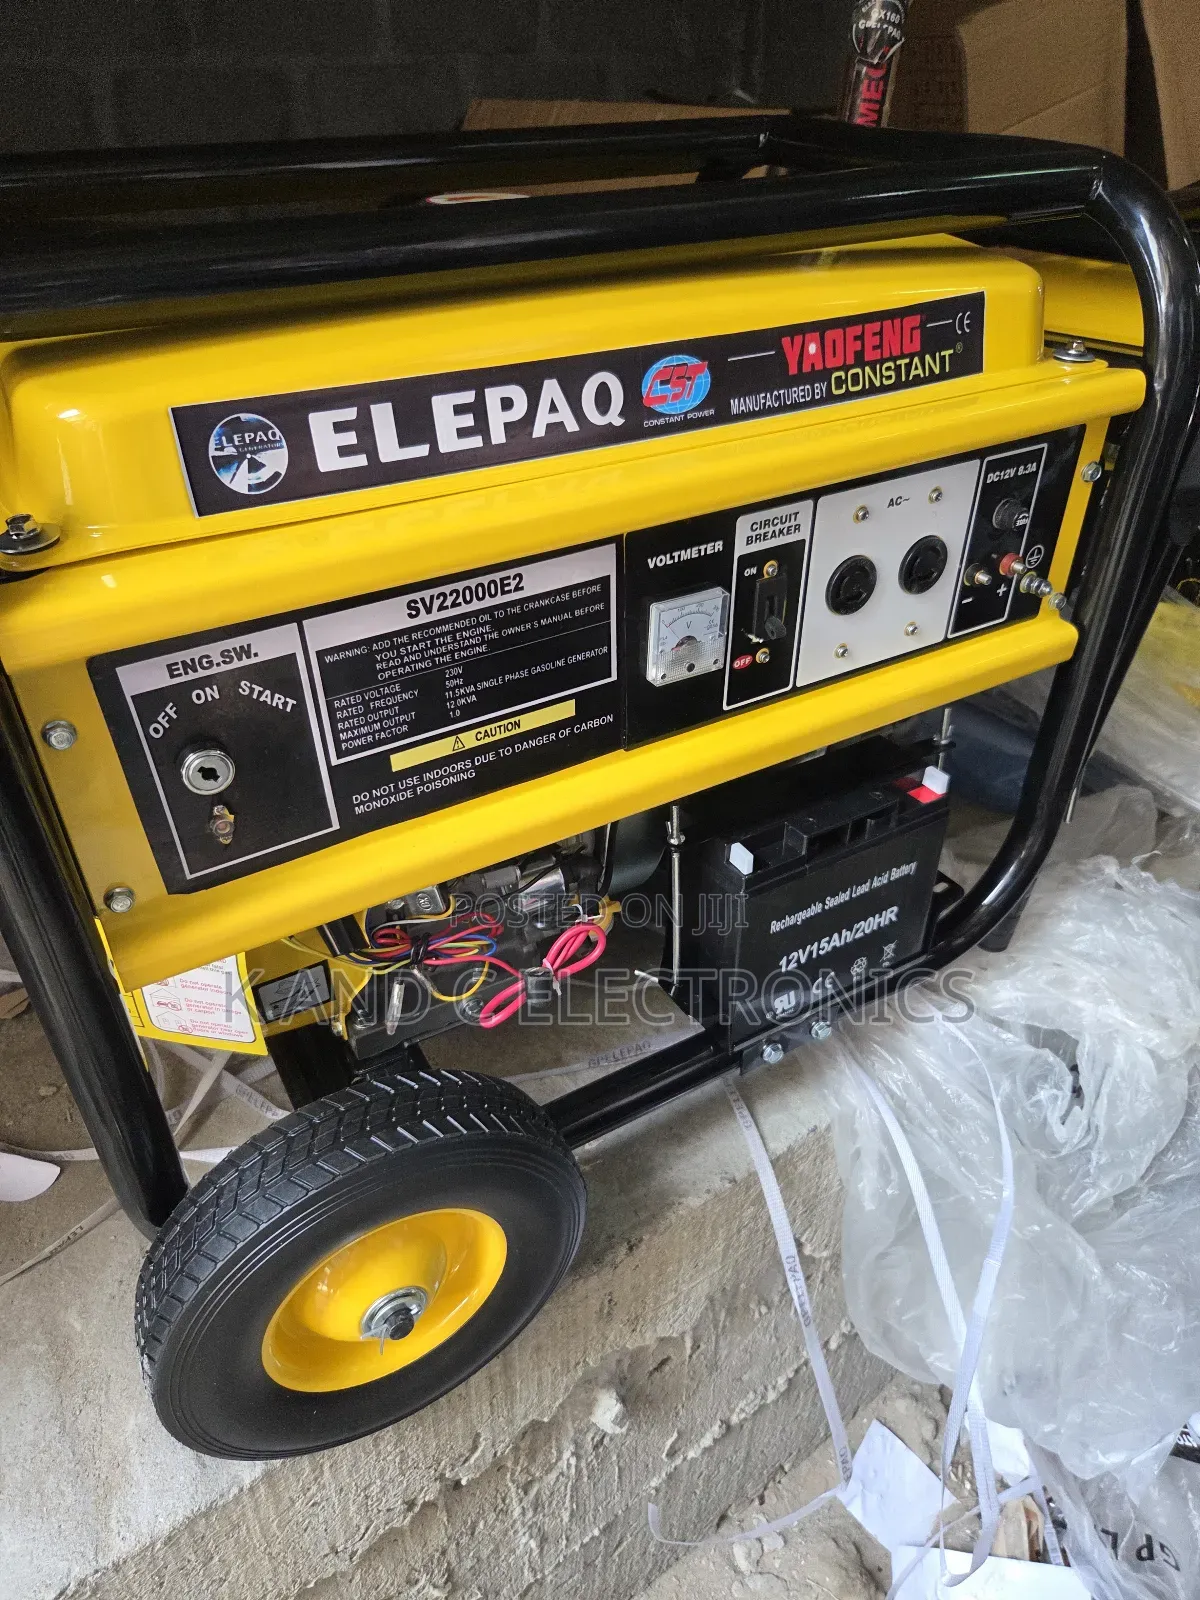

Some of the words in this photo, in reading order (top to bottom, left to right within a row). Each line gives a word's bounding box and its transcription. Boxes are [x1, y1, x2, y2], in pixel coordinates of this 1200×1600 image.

[781, 314, 921, 376] YAOFENG
[642, 361, 709, 408] CST
[730, 384, 813, 416] MANUFACTURED
[814, 381, 828, 400] BY
[831, 350, 954, 396] CONSTANT
[308, 371, 626, 473] ELEPAQ
[643, 413, 686, 428] CONSTANT
[686, 408, 715, 421] POWER
[212, 428, 282, 450] ELEPAQ
[986, 467, 1016, 484] DC12V
[1017, 462, 1037, 476] 8.3A
[745, 523, 801, 546] BREAKER
[749, 511, 800, 533] CIRCUIT
[647, 540, 724, 569] VOLTMETER
[743, 566, 758, 577] ON
[406, 572, 525, 619] SV22000E2
[324, 645, 371, 664] WARNING:
[372, 639, 391, 652] ADD
[393, 634, 410, 646] THE
[411, 616, 477, 641] RECOMMENDED
[478, 613, 492, 624] OIL
[494, 610, 505, 620] TO
[506, 605, 522, 617] THE
[523, 594, 571, 612] CRANKCASE
[572, 583, 602, 599] BEFORE
[375, 650, 397, 662] YOU
[400, 641, 432, 656] START
[434, 634, 453, 646] THE
[456, 624, 495, 640] ENGINE.
[376, 658, 401, 671] READ
[403, 652, 422, 664] AND
[423, 636, 482, 659] UNDERSTAND
[484, 629, 500, 641] THE
[501, 620, 539, 637] OWNER'S
[540, 612, 573, 628] MANUAL
[574, 602, 605, 618] BEFORE
[686, 620, 693, 629] V
[166, 642, 259, 680] ENG.SW.
[377, 660, 433, 682] OPERATING
[434, 653, 453, 665] THE
[454, 644, 491, 660] ENGINE.
[732, 656, 753, 669] OFF
[191, 684, 220, 705] ON
[238, 680, 297, 714] START
[334, 694, 363, 709] RATED
[363, 683, 402, 701] VOLTAGE
[445, 665, 464, 678] 230V
[336, 704, 365, 719] RATED
[370, 688, 420, 710] FREQUENCY
[445, 678, 464, 690] 50Hz
[337, 716, 366, 731] RATED
[368, 706, 400, 722] OUTPUT
[445, 685, 476, 700] 11.5KVA
[476, 676, 503, 692] SINGLE
[504, 668, 529, 683] PHASE
[530, 657, 566, 675] GASOLINE
[567, 645, 609, 665] GENERATOR
[148, 702, 180, 740] OFF
[339, 722, 382, 741] MAXIMUM
[382, 711, 417, 728] OUTPUT
[446, 694, 478, 710] 12.0KVA
[341, 733, 375, 751] POWER
[375, 724, 410, 741] FACTOR
[449, 709, 461, 720] 1.0
[475, 719, 521, 742] CAUTION
[352, 791, 370, 804] DO
[372, 783, 396, 798] NOT
[398, 775, 421, 791] USE
[423, 758, 472, 783] INDOORS
[474, 751, 497, 766] DUE
[498, 746, 513, 758] TO
[515, 732, 557, 753] DANGER
[558, 727, 571, 740] OF
[573, 713, 614, 735] CARBON
[354, 792, 415, 816] MONOXIDE
[416, 769, 476, 795] POISONING
[770, 902, 823, 934] Rechargeable
[824, 887, 850, 911] Sealed
[851, 879, 871, 899] Lead
[872, 869, 889, 889] Acid
[889, 861, 918, 883] Battery
[778, 904, 900, 973] 12V15Ah/20HR
